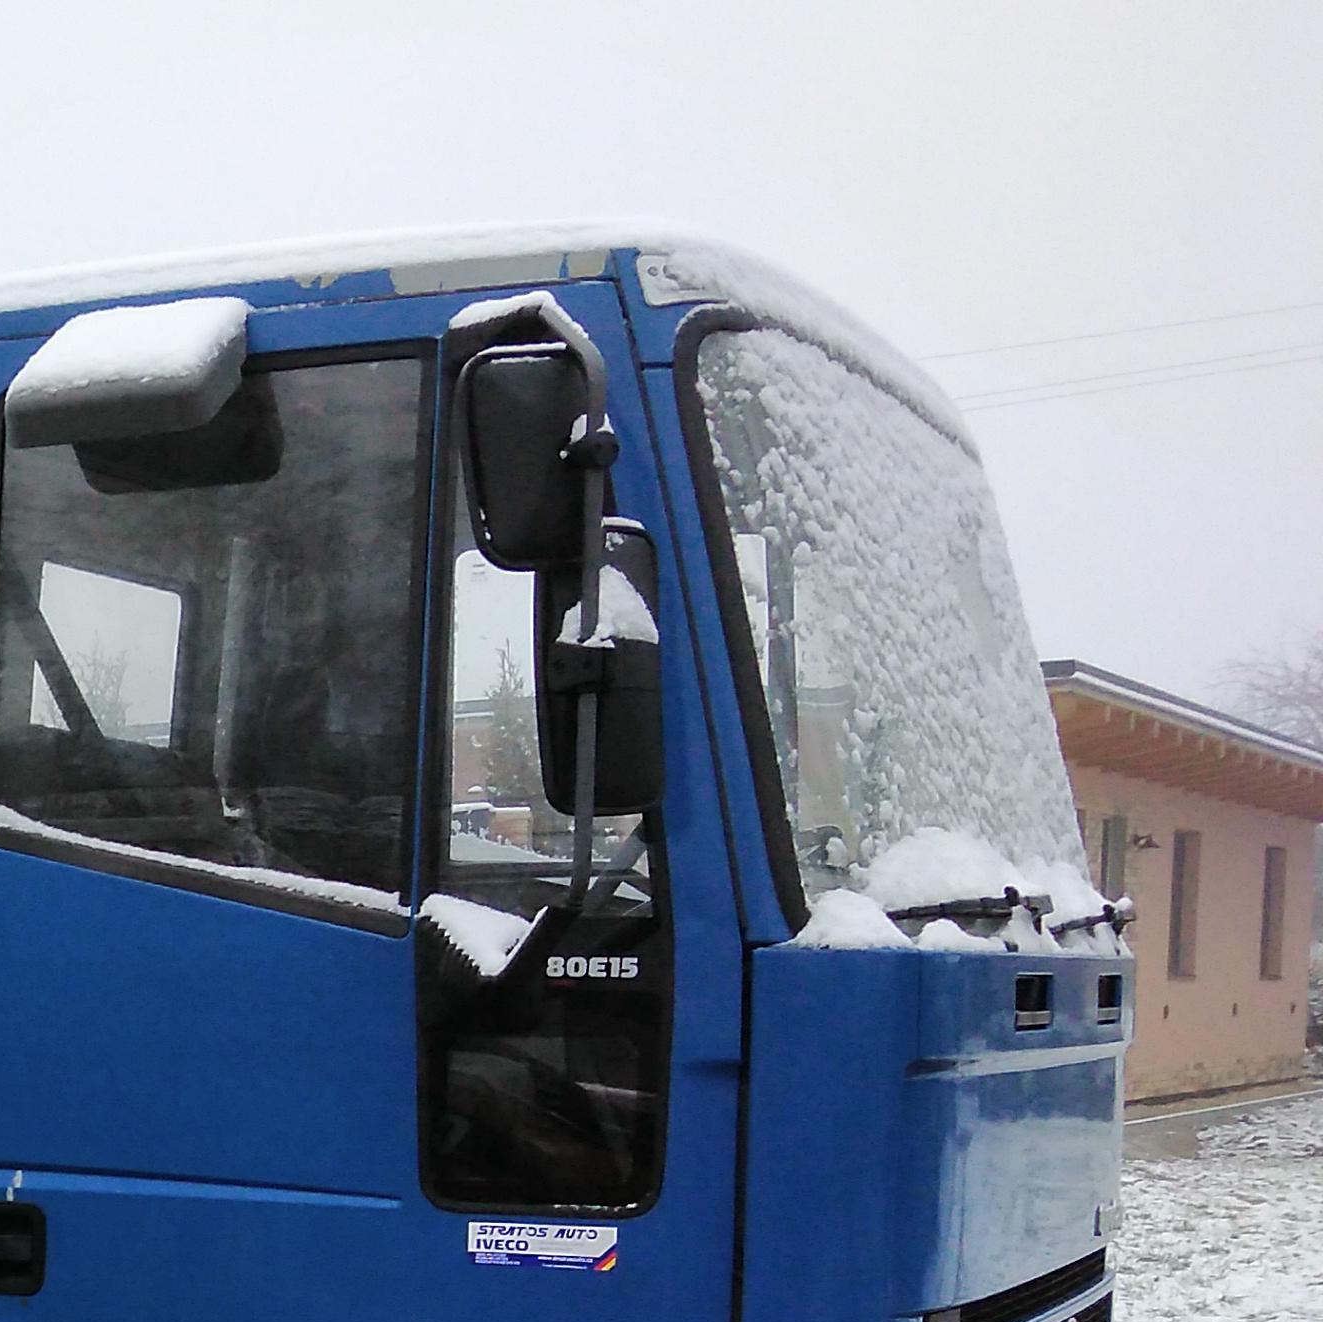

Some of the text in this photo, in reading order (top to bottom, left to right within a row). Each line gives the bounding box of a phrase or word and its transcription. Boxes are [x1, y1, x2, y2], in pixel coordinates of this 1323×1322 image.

[546, 956, 638, 978] 80E15
[477, 1225, 599, 1240] STRATOS AUTO
[476, 1239, 529, 1251] IVECO
